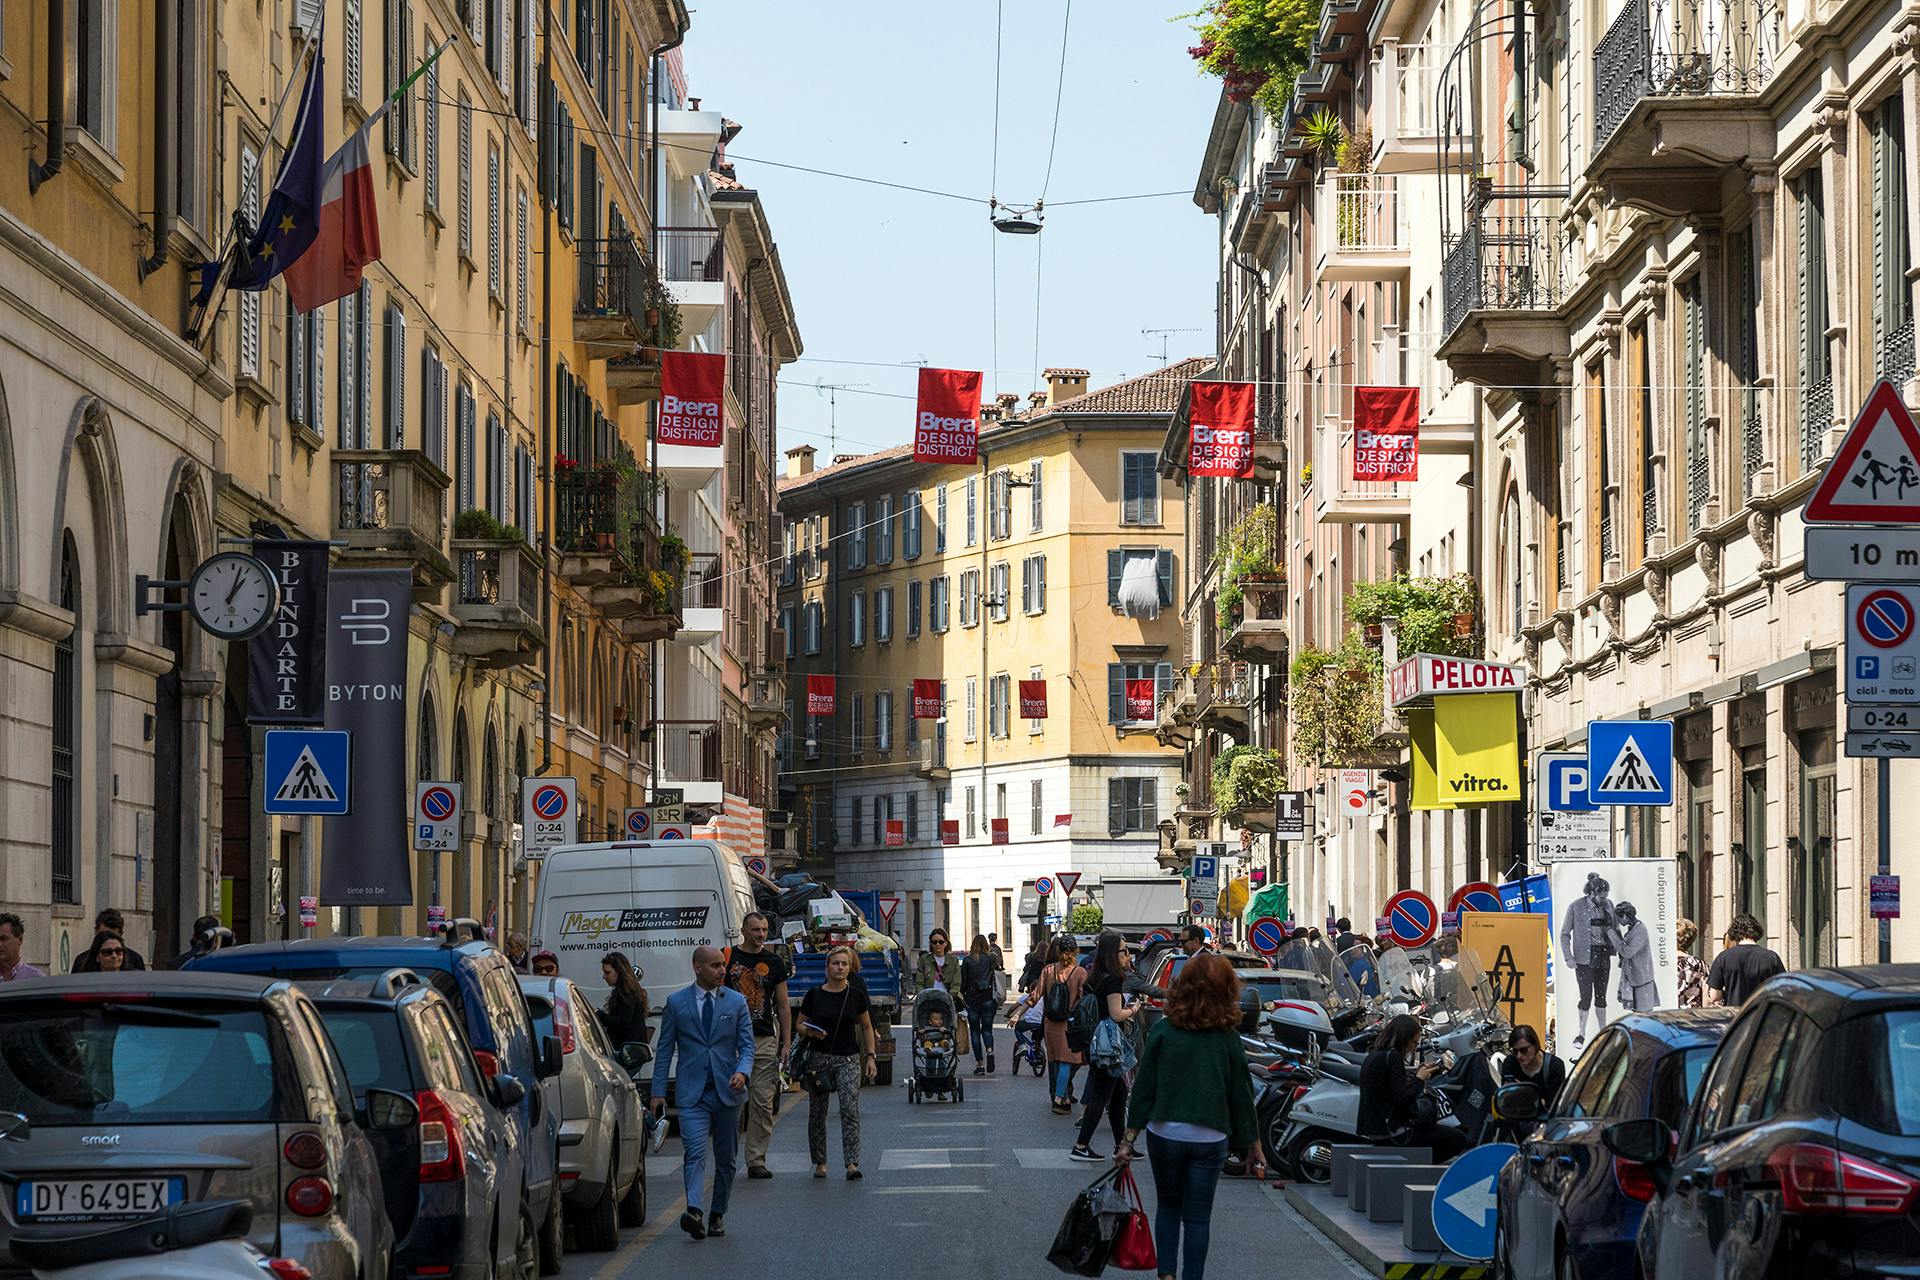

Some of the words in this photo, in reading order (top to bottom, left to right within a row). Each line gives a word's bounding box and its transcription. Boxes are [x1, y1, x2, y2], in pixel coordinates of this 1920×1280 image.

[663, 395, 719, 417] Brera
[662, 415, 719, 429] DESIGN
[919, 411, 977, 433] Brera
[661, 427, 717, 441] DISTRICT
[919, 432, 977, 445] DESIGN
[1193, 425, 1250, 446] Brera
[1357, 430, 1416, 449] Brera
[917, 443, 974, 457] DISTRICT
[1192, 445, 1251, 458] DESIGN
[1356, 450, 1416, 462] DESIGN
[1191, 457, 1248, 470] DISTRICT
[1356, 461, 1415, 474] DISTRICT
[1850, 543, 1881, 567] 10
[1895, 549, 1918, 566] m
[276, 551, 301, 711] BLINDARTE
[1431, 659, 1515, 690] PELOTA
[329, 685, 403, 701] BYTON
[809, 693, 833, 702] Brera
[1857, 686, 1878, 695] cicli
[1889, 687, 1915, 696] moto
[916, 697, 939, 705] Brera
[1128, 698, 1152, 706] Brera
[1449, 773, 1508, 793] vitra.
[1560, 767, 1589, 805] P
[537, 823, 562, 832] 0-24
[1656, 866, 1667, 921] montagna
[562, 913, 616, 940] Magic
[679, 910, 706, 919] und
[620, 918, 703, 929] Medientechnik
[1656, 923, 1666, 934] di
[560, 937, 711, 951] www.magic-medientechnik.de
[1659, 936, 1668, 967] gente
[81, 1134, 121, 1146] smart
